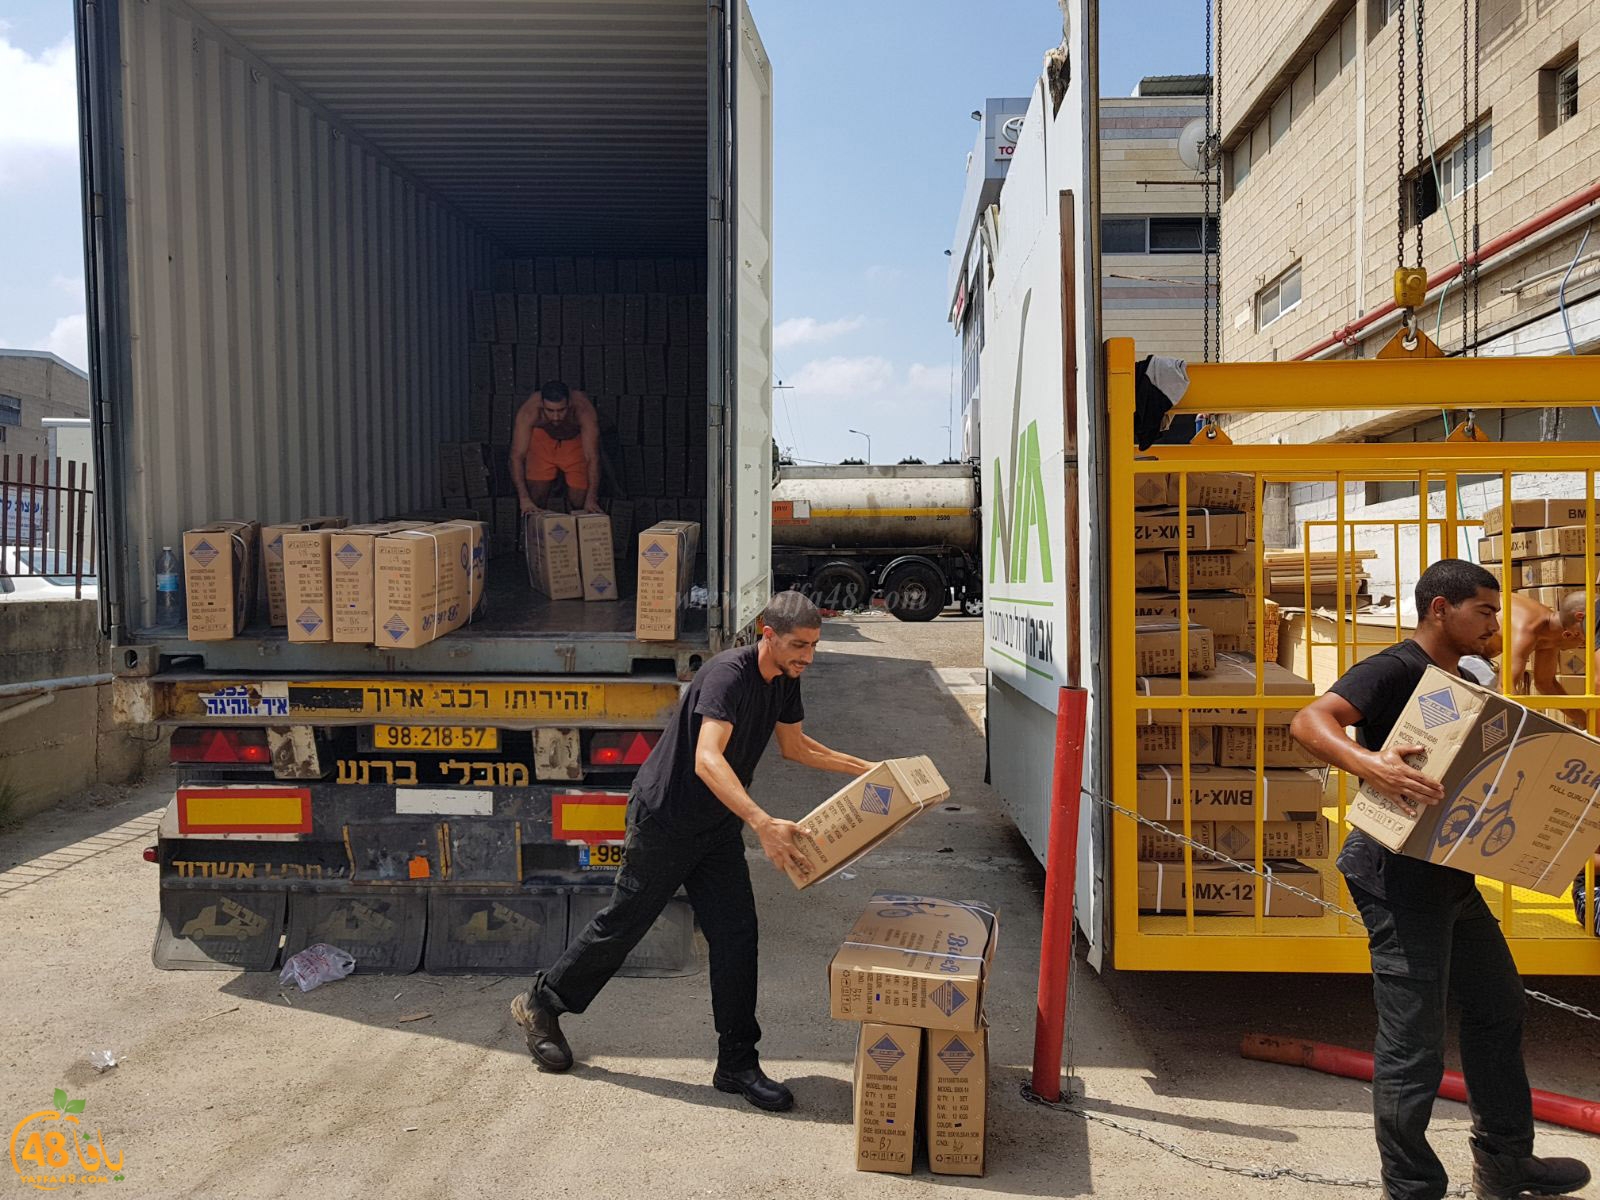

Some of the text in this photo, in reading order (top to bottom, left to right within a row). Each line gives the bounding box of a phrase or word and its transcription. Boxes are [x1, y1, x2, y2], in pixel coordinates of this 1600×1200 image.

[999, 146, 1016, 155] TO
[262, 698, 288, 716] איך
[367, 688, 424, 712] ארוך
[440, 689, 489, 709] רכב
[337, 760, 529, 786] מובלי ברנע
[1173, 790, 1253, 806] BMX-1"
